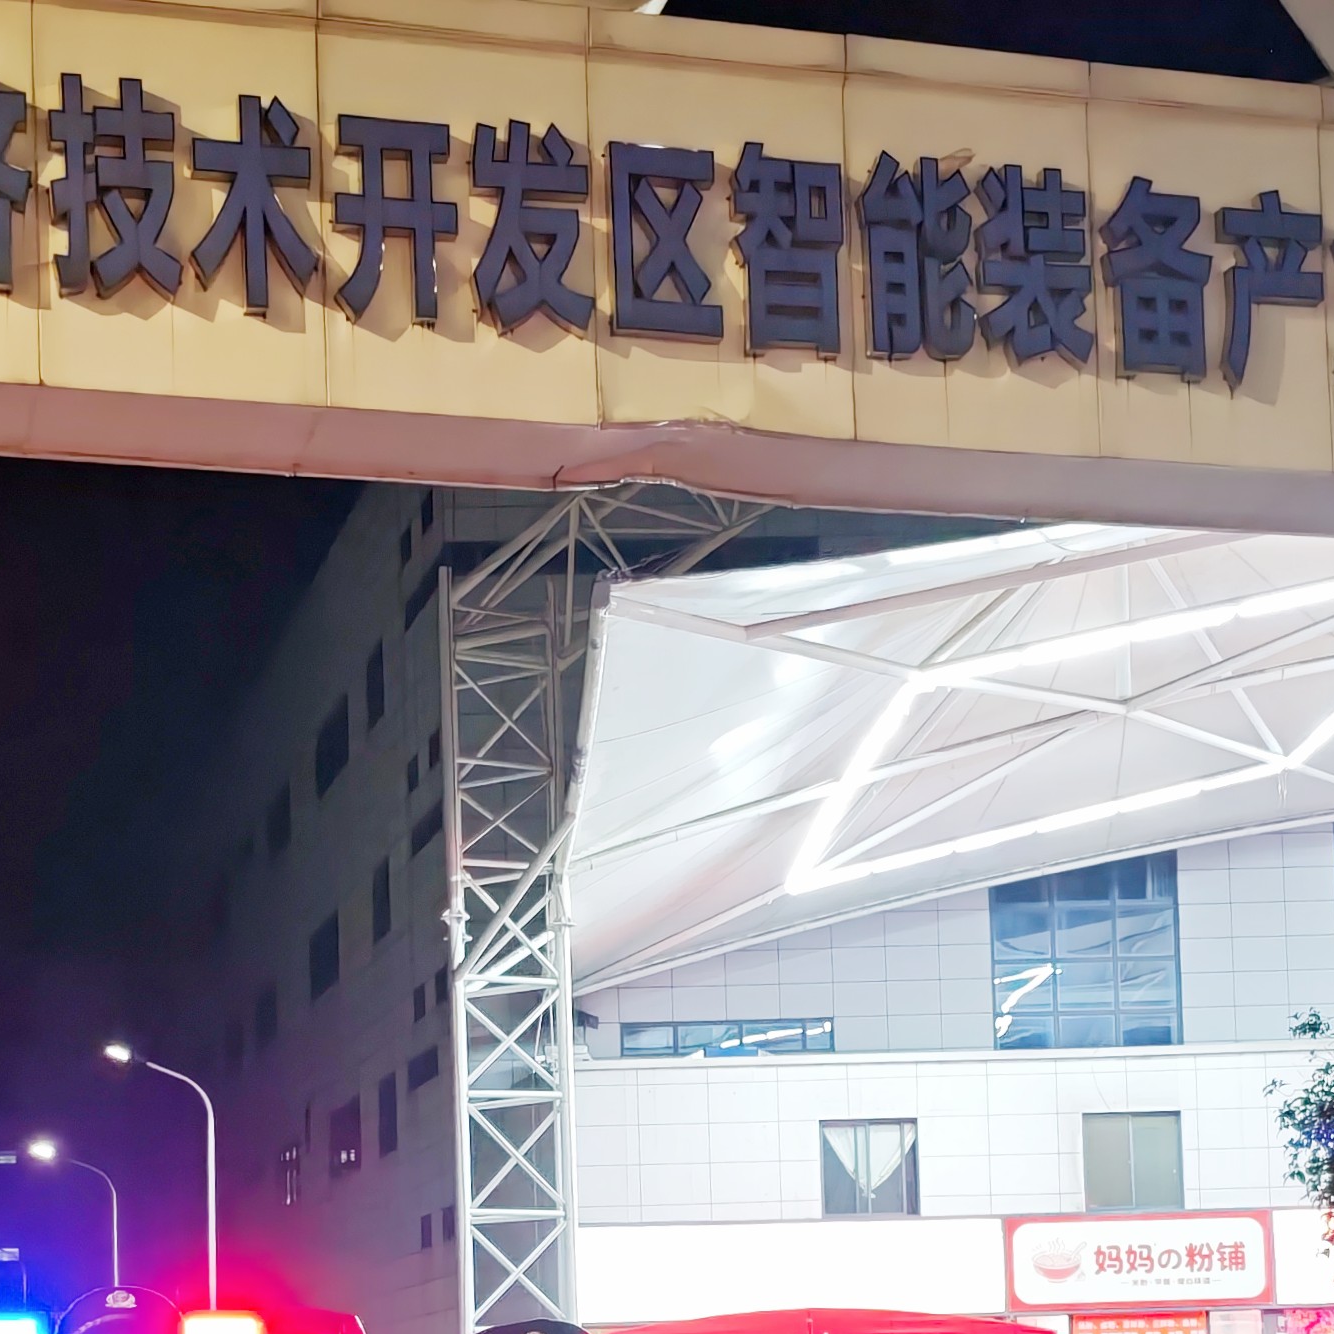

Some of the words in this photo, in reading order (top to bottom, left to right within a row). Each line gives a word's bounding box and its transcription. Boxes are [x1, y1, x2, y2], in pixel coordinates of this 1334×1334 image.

[1094, 1242, 1246, 1274] 妈妈の粉铺
